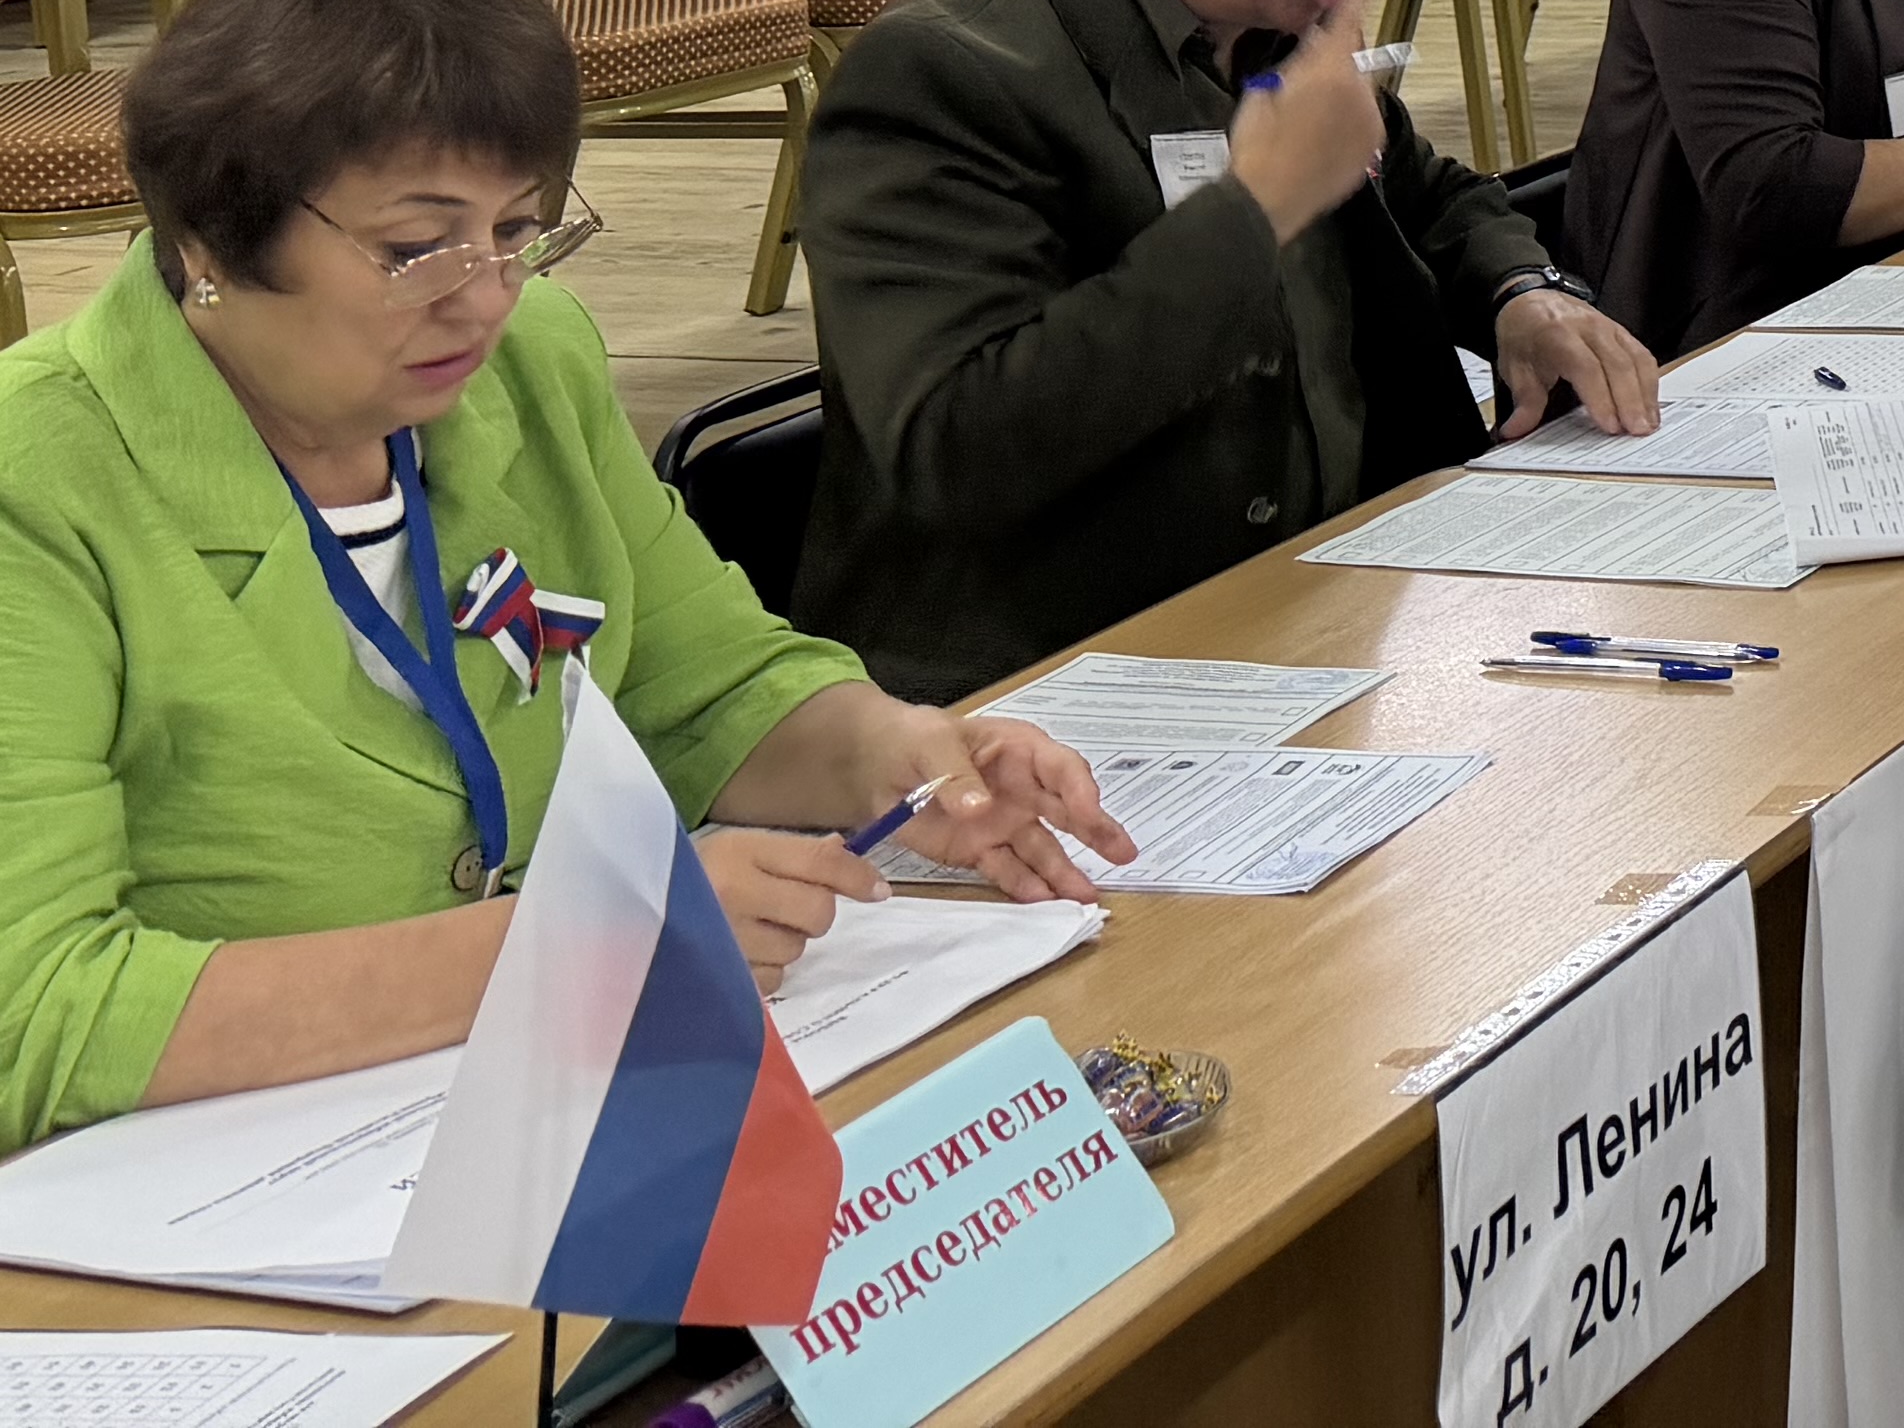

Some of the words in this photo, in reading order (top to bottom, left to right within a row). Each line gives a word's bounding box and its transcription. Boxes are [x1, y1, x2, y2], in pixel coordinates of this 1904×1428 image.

[790, 1129, 1119, 1365] председателя
[826, 1079, 1068, 1255] меститель
[1450, 1193, 1532, 1332] ул.
[1552, 1012, 1753, 1220] Ленина
[1497, 1337, 1549, 1428] д.
[1569, 1237, 1641, 1359] 20,
[1660, 1155, 1719, 1276] 24
